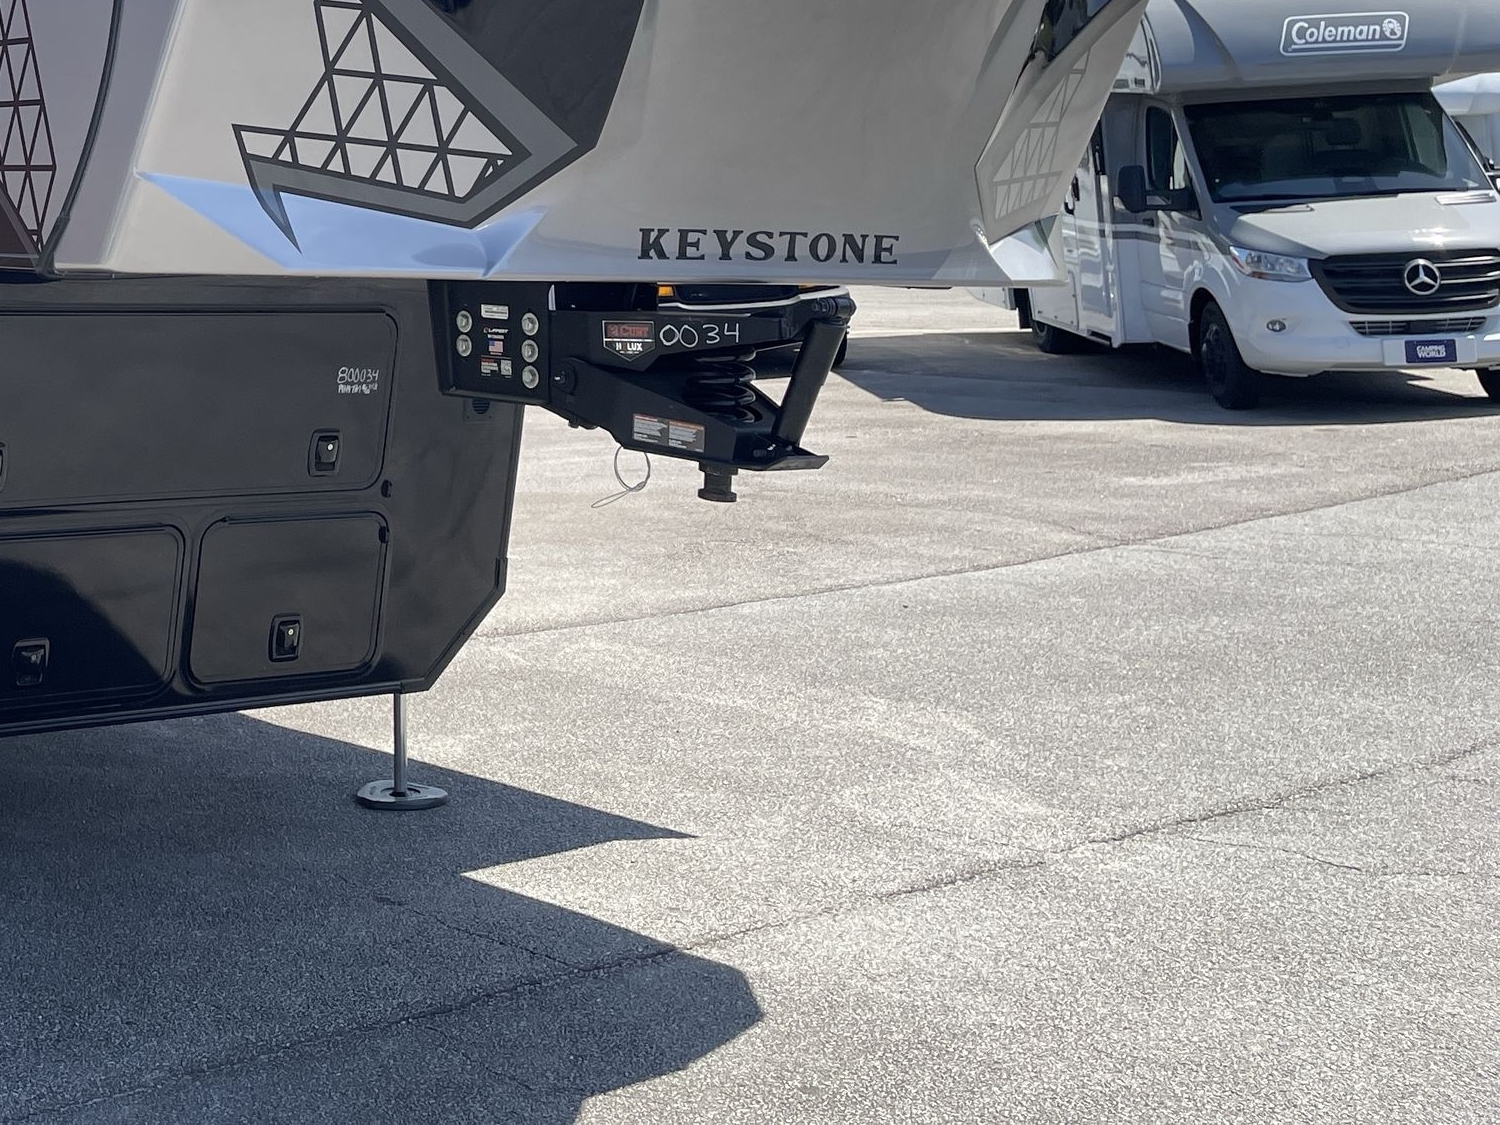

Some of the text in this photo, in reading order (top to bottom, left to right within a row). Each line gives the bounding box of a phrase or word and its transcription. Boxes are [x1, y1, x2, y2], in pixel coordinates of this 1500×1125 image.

[1291, 21, 1381, 44] Coleman
[638, 228, 899, 264] KEYSTONE
[660, 323, 739, 347] 0034
[337, 367, 379, 383] 800034
